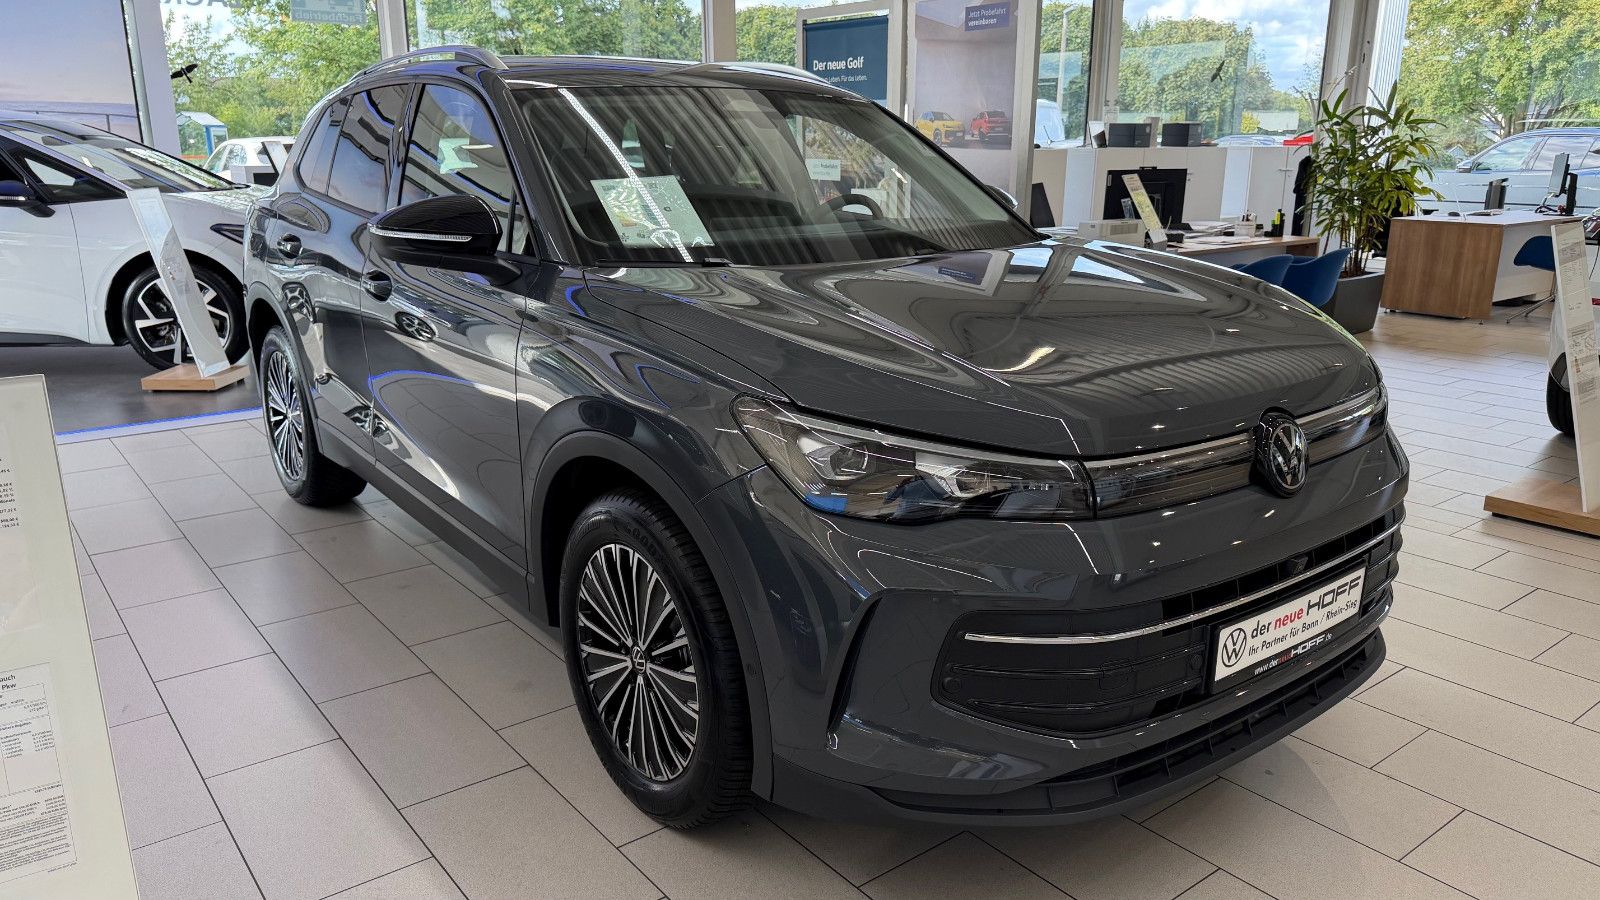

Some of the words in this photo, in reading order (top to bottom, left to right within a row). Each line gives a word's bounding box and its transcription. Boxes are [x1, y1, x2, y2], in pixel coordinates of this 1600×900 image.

[980, 8, 1007, 16] Probefahrt
[813, 60, 826, 71] Der
[827, 60, 846, 70] neue
[847, 56, 865, 69] Golf
[1251, 620, 1272, 639] der
[1273, 608, 1304, 631] neue
[1306, 575, 1362, 617] HOFF
[1248, 644, 1259, 657] Ihr
[1261, 634, 1288, 651] Partner
[1289, 627, 1300, 638] für
[1301, 619, 1319, 633] Bonn
[1326, 600, 1358, 621] Rhein-Sieg
[1, 683, 17, 691] Pkw
